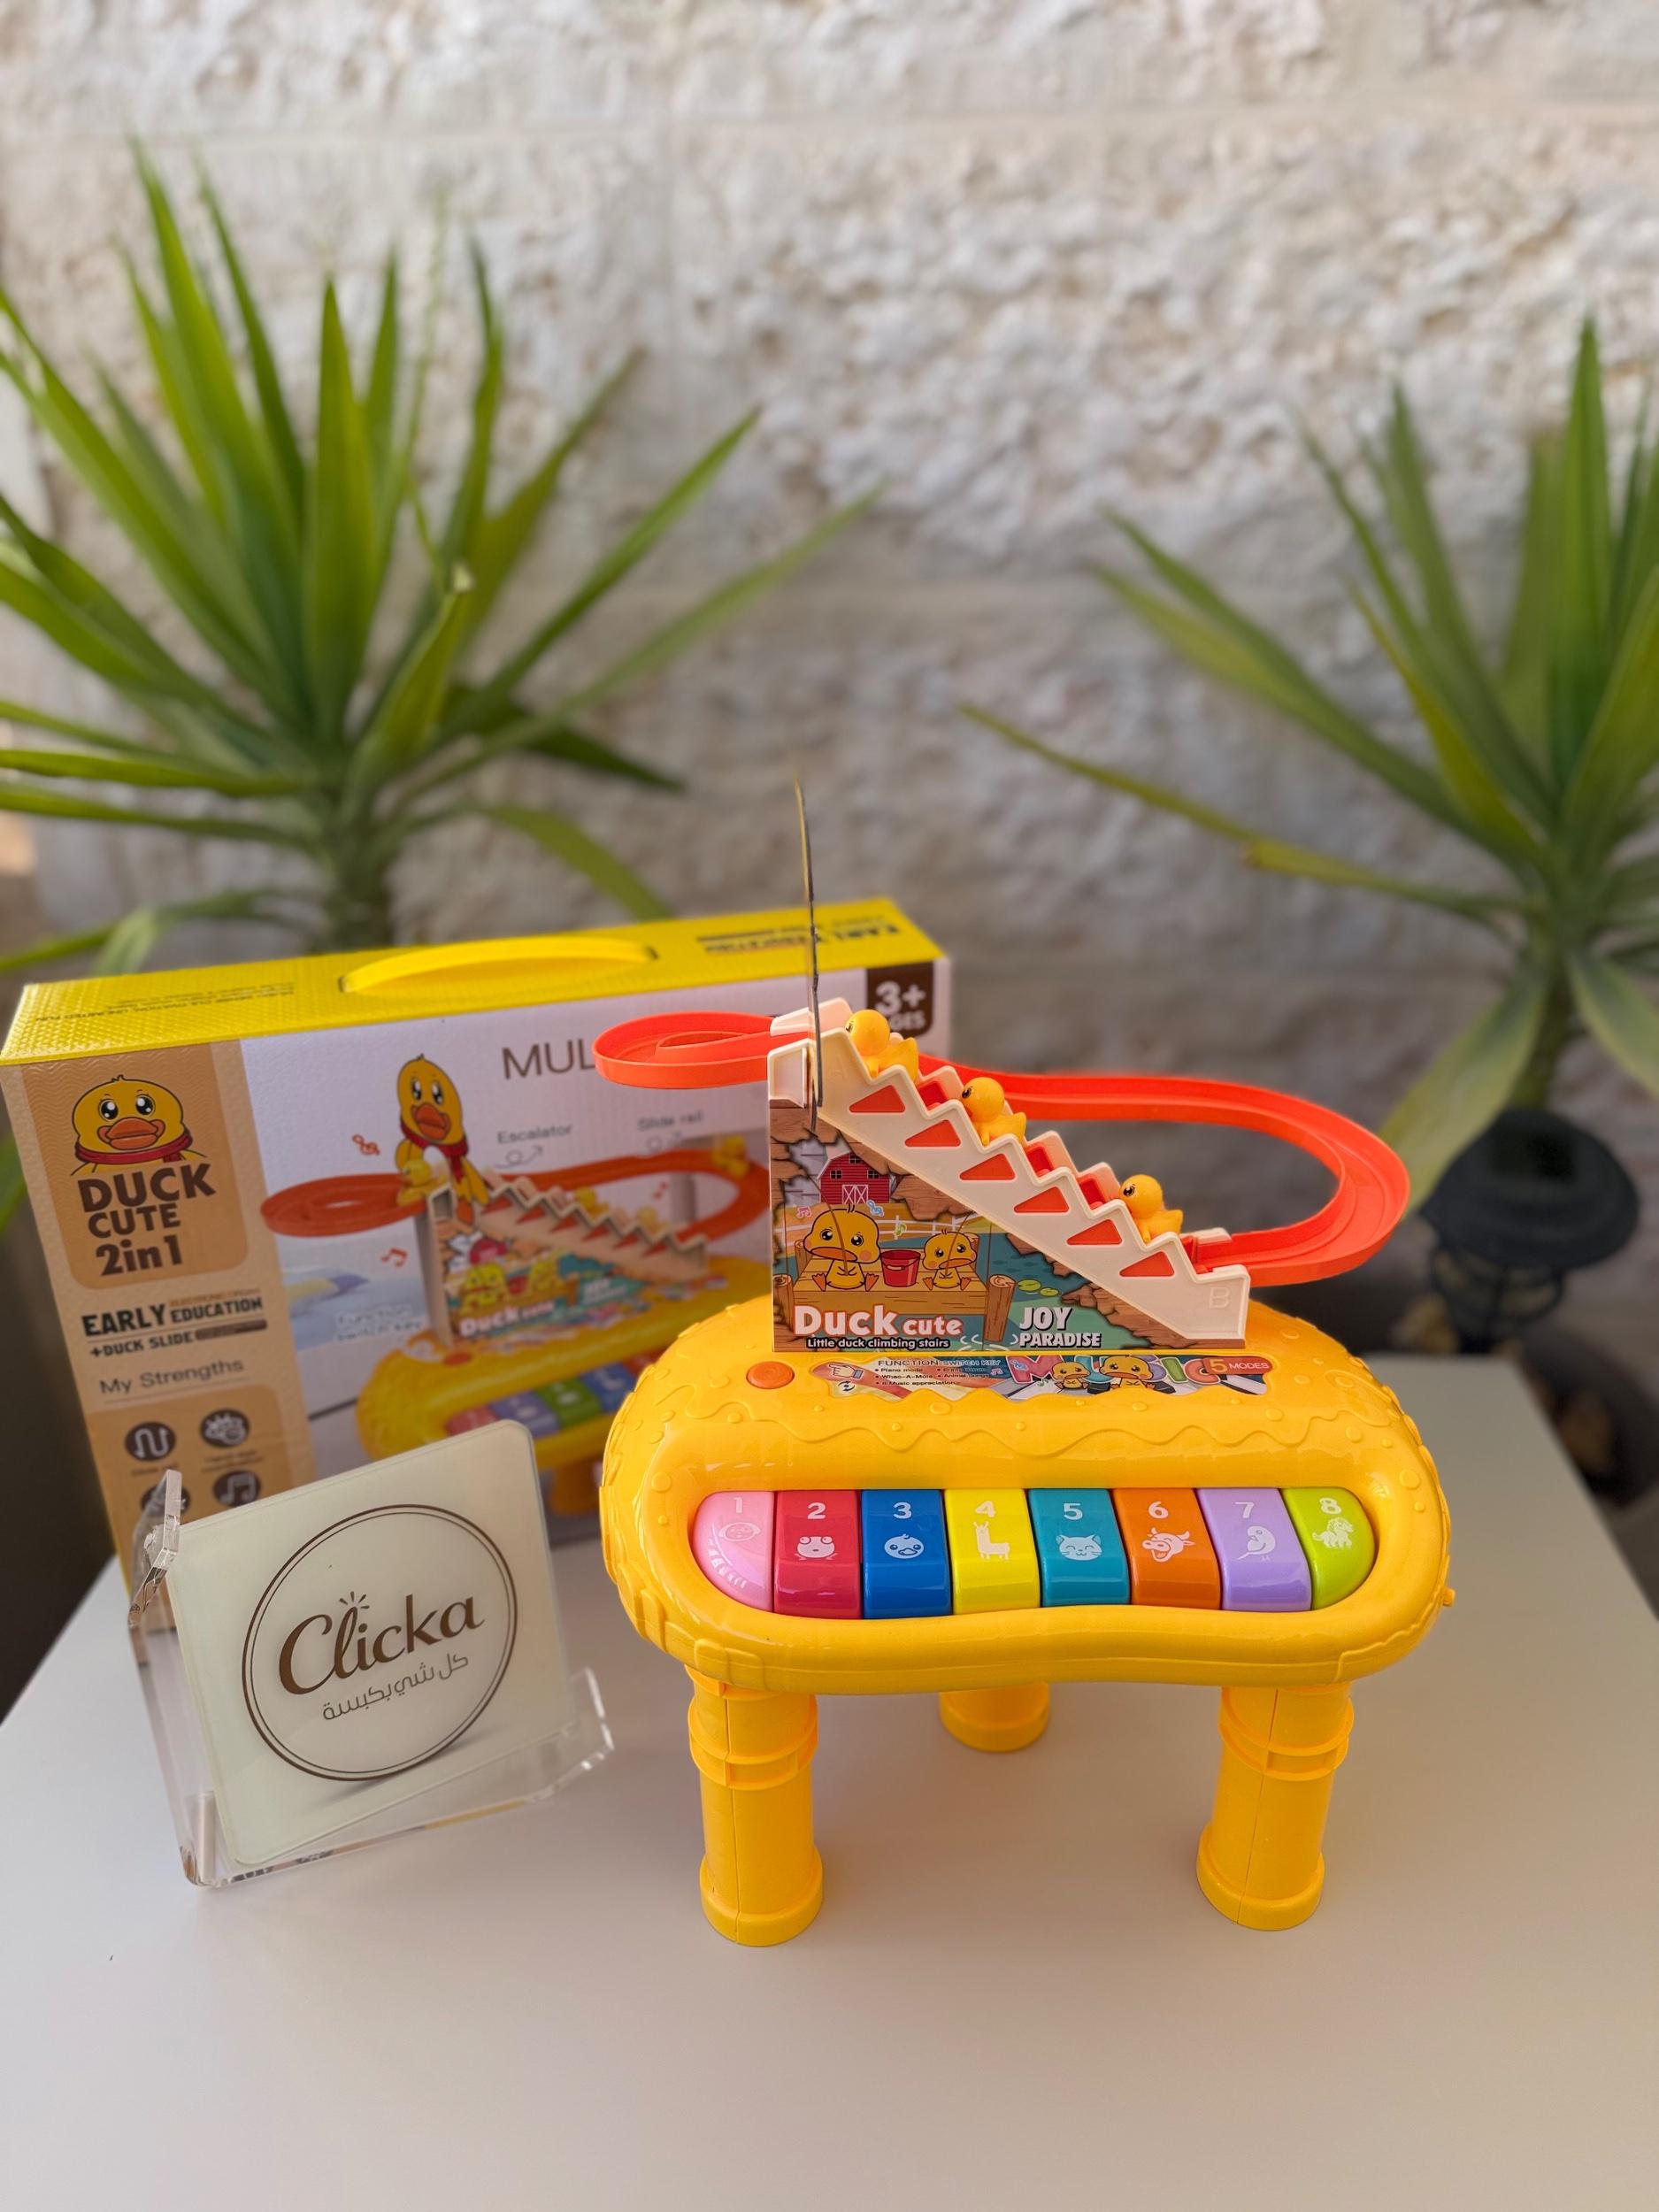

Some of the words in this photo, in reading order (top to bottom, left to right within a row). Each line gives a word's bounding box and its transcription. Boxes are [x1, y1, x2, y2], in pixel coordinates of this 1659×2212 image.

[874, 980, 926, 1017] 3+
[497, 1124, 572, 1145] Escalator
[77, 1163, 217, 1212] DUCK
[88, 1202, 181, 1239] CUTE
[1209, 1286, 1231, 1310] B
[81, 1303, 166, 1337] EARLY
[170, 1297, 263, 1324] EDUCATION
[794, 1304, 898, 1337] Duck
[902, 1317, 962, 1336] cute
[1018, 1306, 1073, 1332] JOY
[150, 1331, 195, 1350] SLIDE
[806, 1338, 836, 1348] Little
[839, 1338, 865, 1348] duck
[868, 1338, 916, 1350] climbing
[918, 1338, 949, 1348] stairs
[1018, 1333, 1102, 1348] PARADISE
[1210, 1358, 1226, 1372] 5
[99, 1379, 132, 1394] My
[139, 1360, 244, 1389] Strengths
[733, 1497, 743, 1514] 1
[807, 1502, 826, 1519] 2
[893, 1502, 912, 1519] 3
[975, 1500, 995, 1517] 4
[1064, 1502, 1084, 1521] 5
[1148, 1501, 1169, 1519] 6
[1234, 1502, 1255, 1519] 7
[1318, 1497, 1341, 1515] 8
[279, 1594, 485, 1695] Clicka
[438, 1653, 469, 1680] كل
[394, 1662, 435, 1696] شي
[322, 1683, 393, 1721] بكبسة
